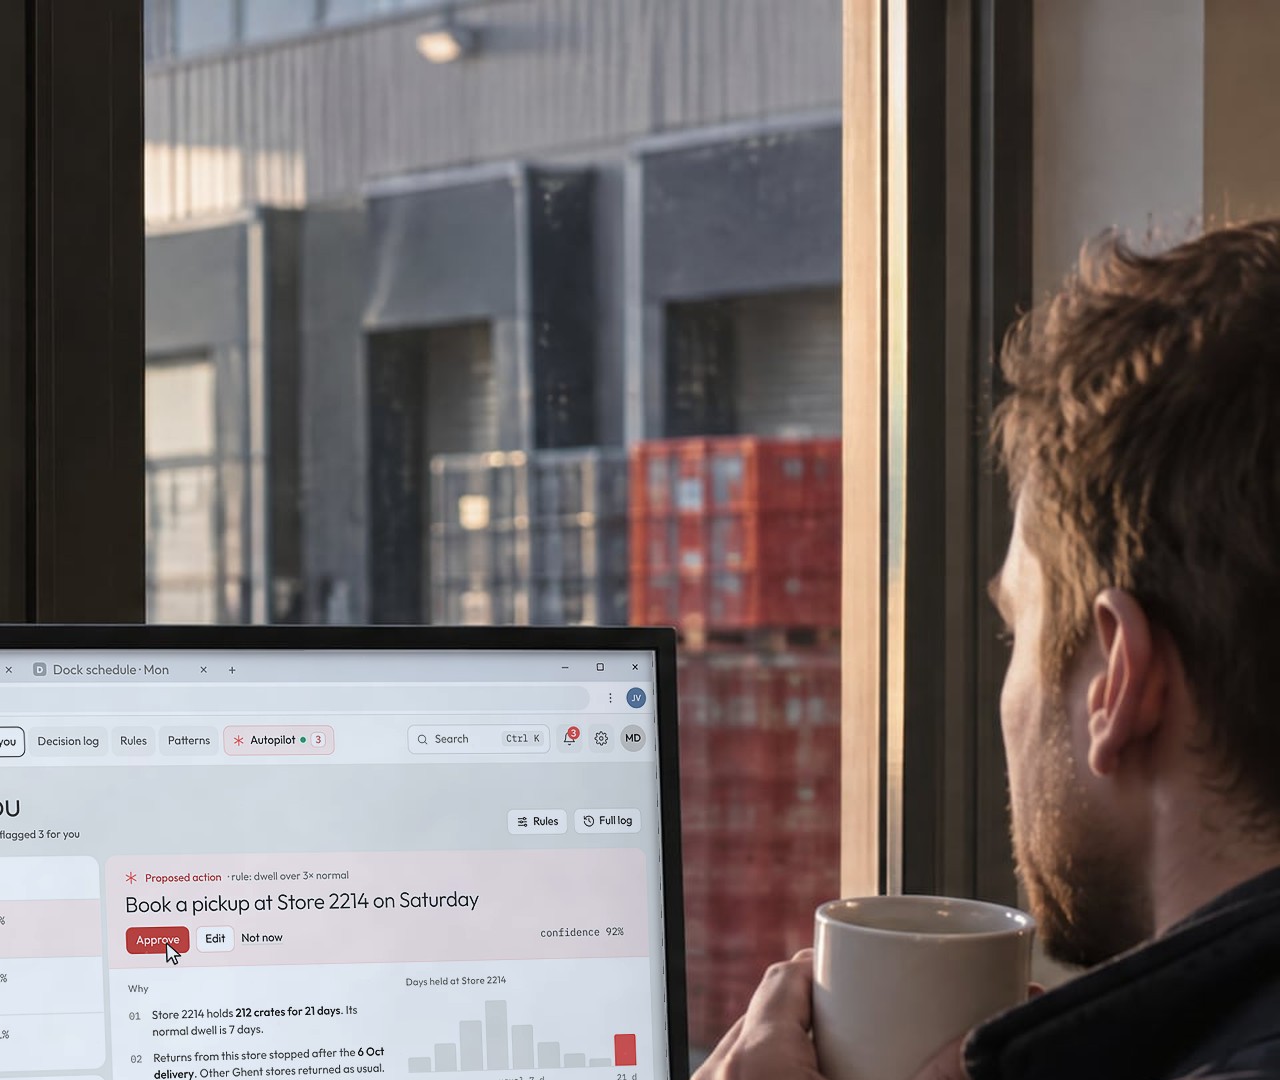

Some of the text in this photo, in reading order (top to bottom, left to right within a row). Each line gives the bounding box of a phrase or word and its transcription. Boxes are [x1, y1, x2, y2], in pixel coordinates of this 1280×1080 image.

[53, 663, 169, 675] Dock schedule Mon
[631, 694, 641, 702] JV
[434, 733, 469, 744] Search
[506, 733, 540, 743] Ctrl K
[570, 728, 578, 738] 3
[625, 733, 641, 742] MD
[37, 735, 99, 748] Decision log
[120, 735, 147, 746] Rules
[168, 735, 210, 745] Patterns
[250, 734, 296, 747] Autopilot
[315, 734, 321, 744] 3
[533, 816, 559, 826] Rules
[599, 815, 632, 827] Full log
[126, 890, 479, 916] Book a pickup at Store 2214 on Saturday
[540, 926, 624, 938] confidence 92%
[136, 935, 180, 947] Approve
[205, 933, 226, 944] Edit
[241, 933, 283, 943] Not now
[128, 1011, 141, 1021] 01
[151, 1005, 358, 1020] Store 2214 holds 212 crates for 21 days. Its
